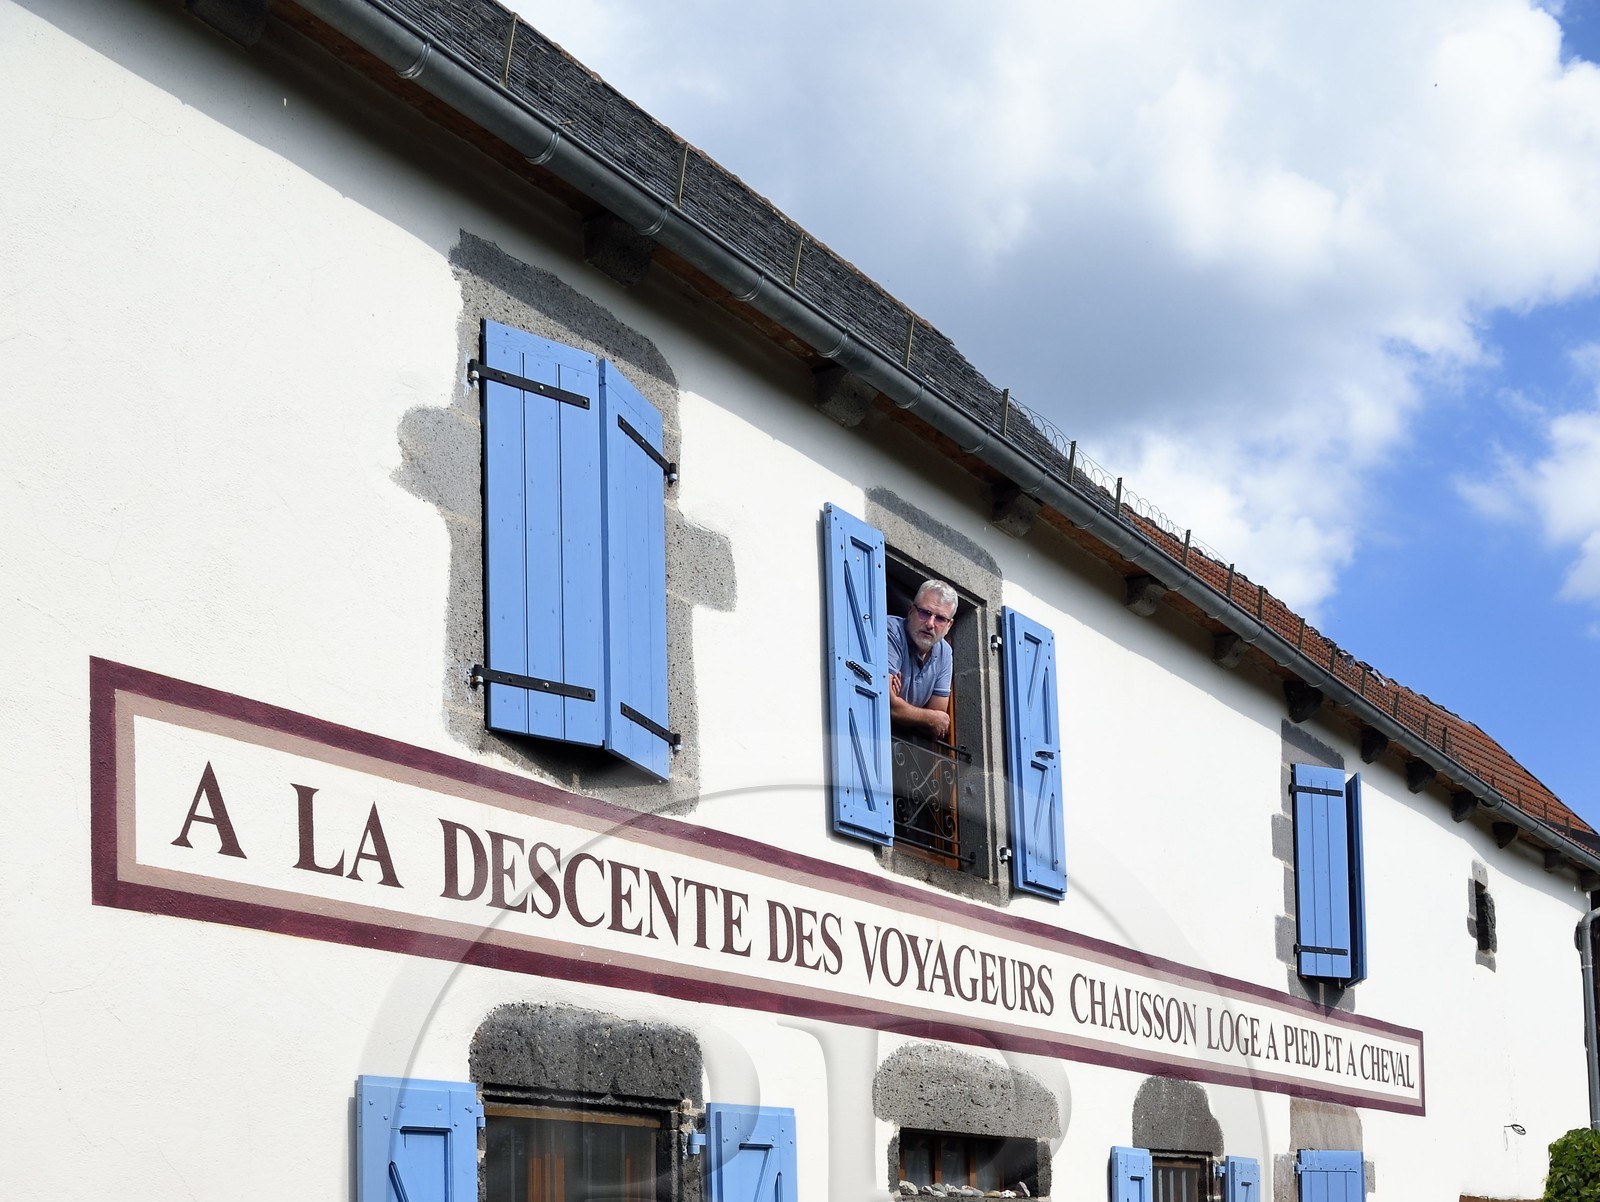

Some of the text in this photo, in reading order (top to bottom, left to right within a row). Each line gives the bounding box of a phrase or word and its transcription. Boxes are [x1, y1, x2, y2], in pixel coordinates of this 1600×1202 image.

[171, 761, 1415, 1089] A LA DESCENTE DES VOYAGEURS CHAUSSON LOGE A PIED ET A CHEVAL
